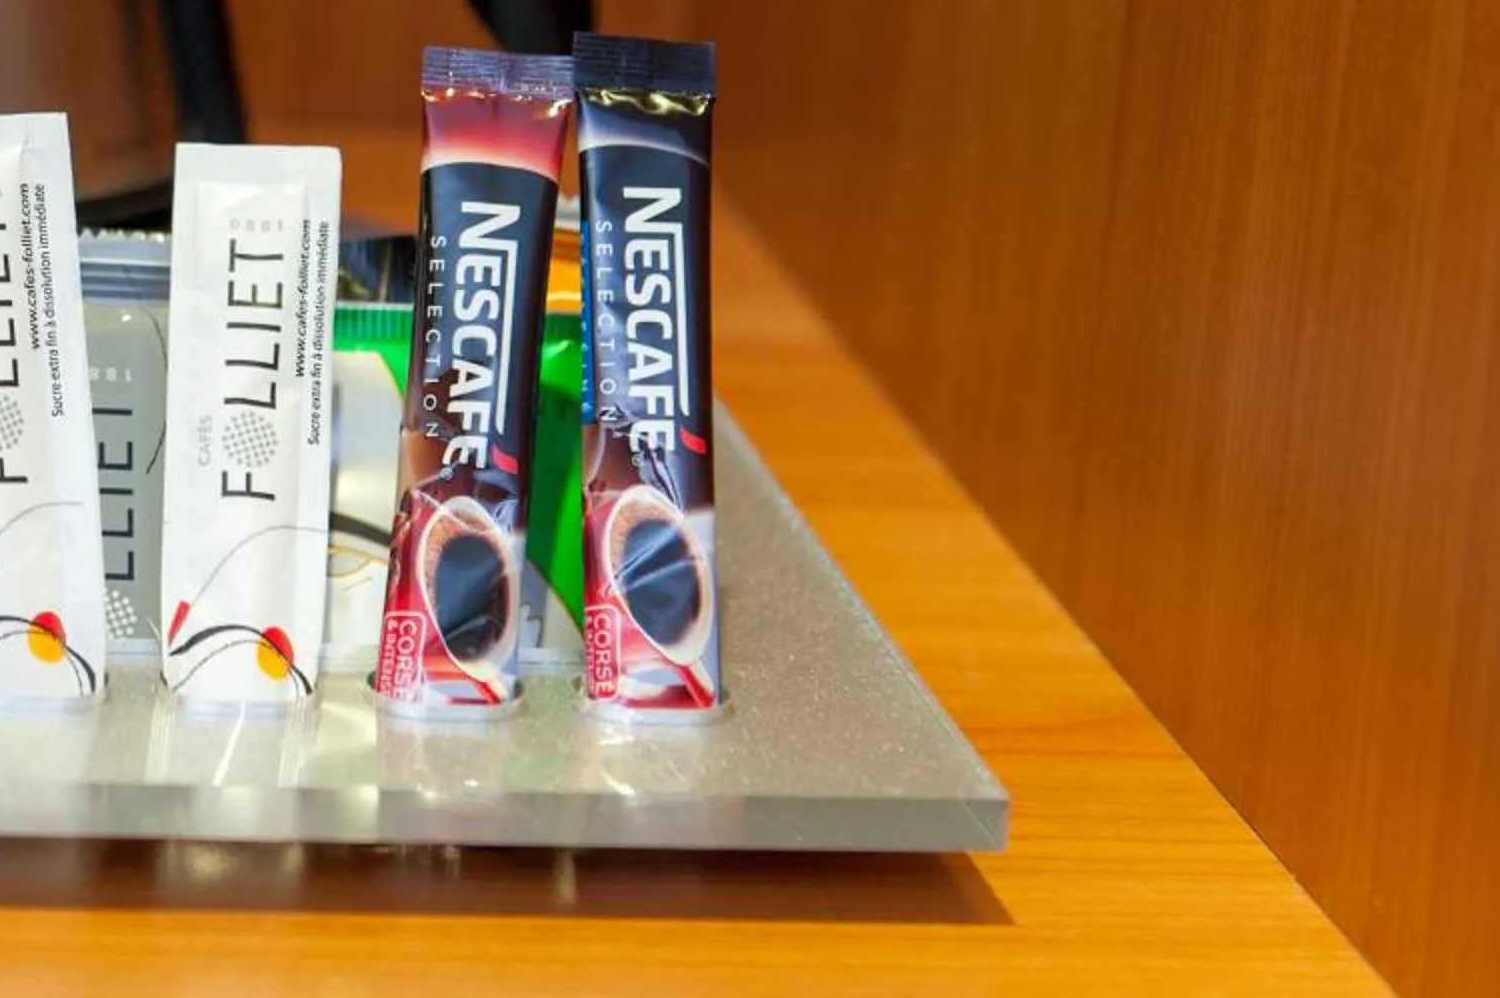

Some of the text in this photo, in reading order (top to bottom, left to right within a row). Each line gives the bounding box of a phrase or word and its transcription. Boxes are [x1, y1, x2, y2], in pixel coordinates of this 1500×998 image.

[19, 182, 40, 350] www.cafes-folliet.com
[39, 251, 55, 318] dissolution
[596, 220, 617, 421] SELECTION
[623, 186, 707, 454] NESCAFÉ
[44, 331, 58, 346] fin
[49, 349, 61, 380] extra
[222, 238, 284, 501] FOLLIET
[310, 363, 322, 378] fin
[423, 235, 446, 437] SELECTION
[442, 201, 521, 474] NESCAFÉ
[50, 384, 65, 418] Sucre
[308, 413, 322, 445] Sucre
